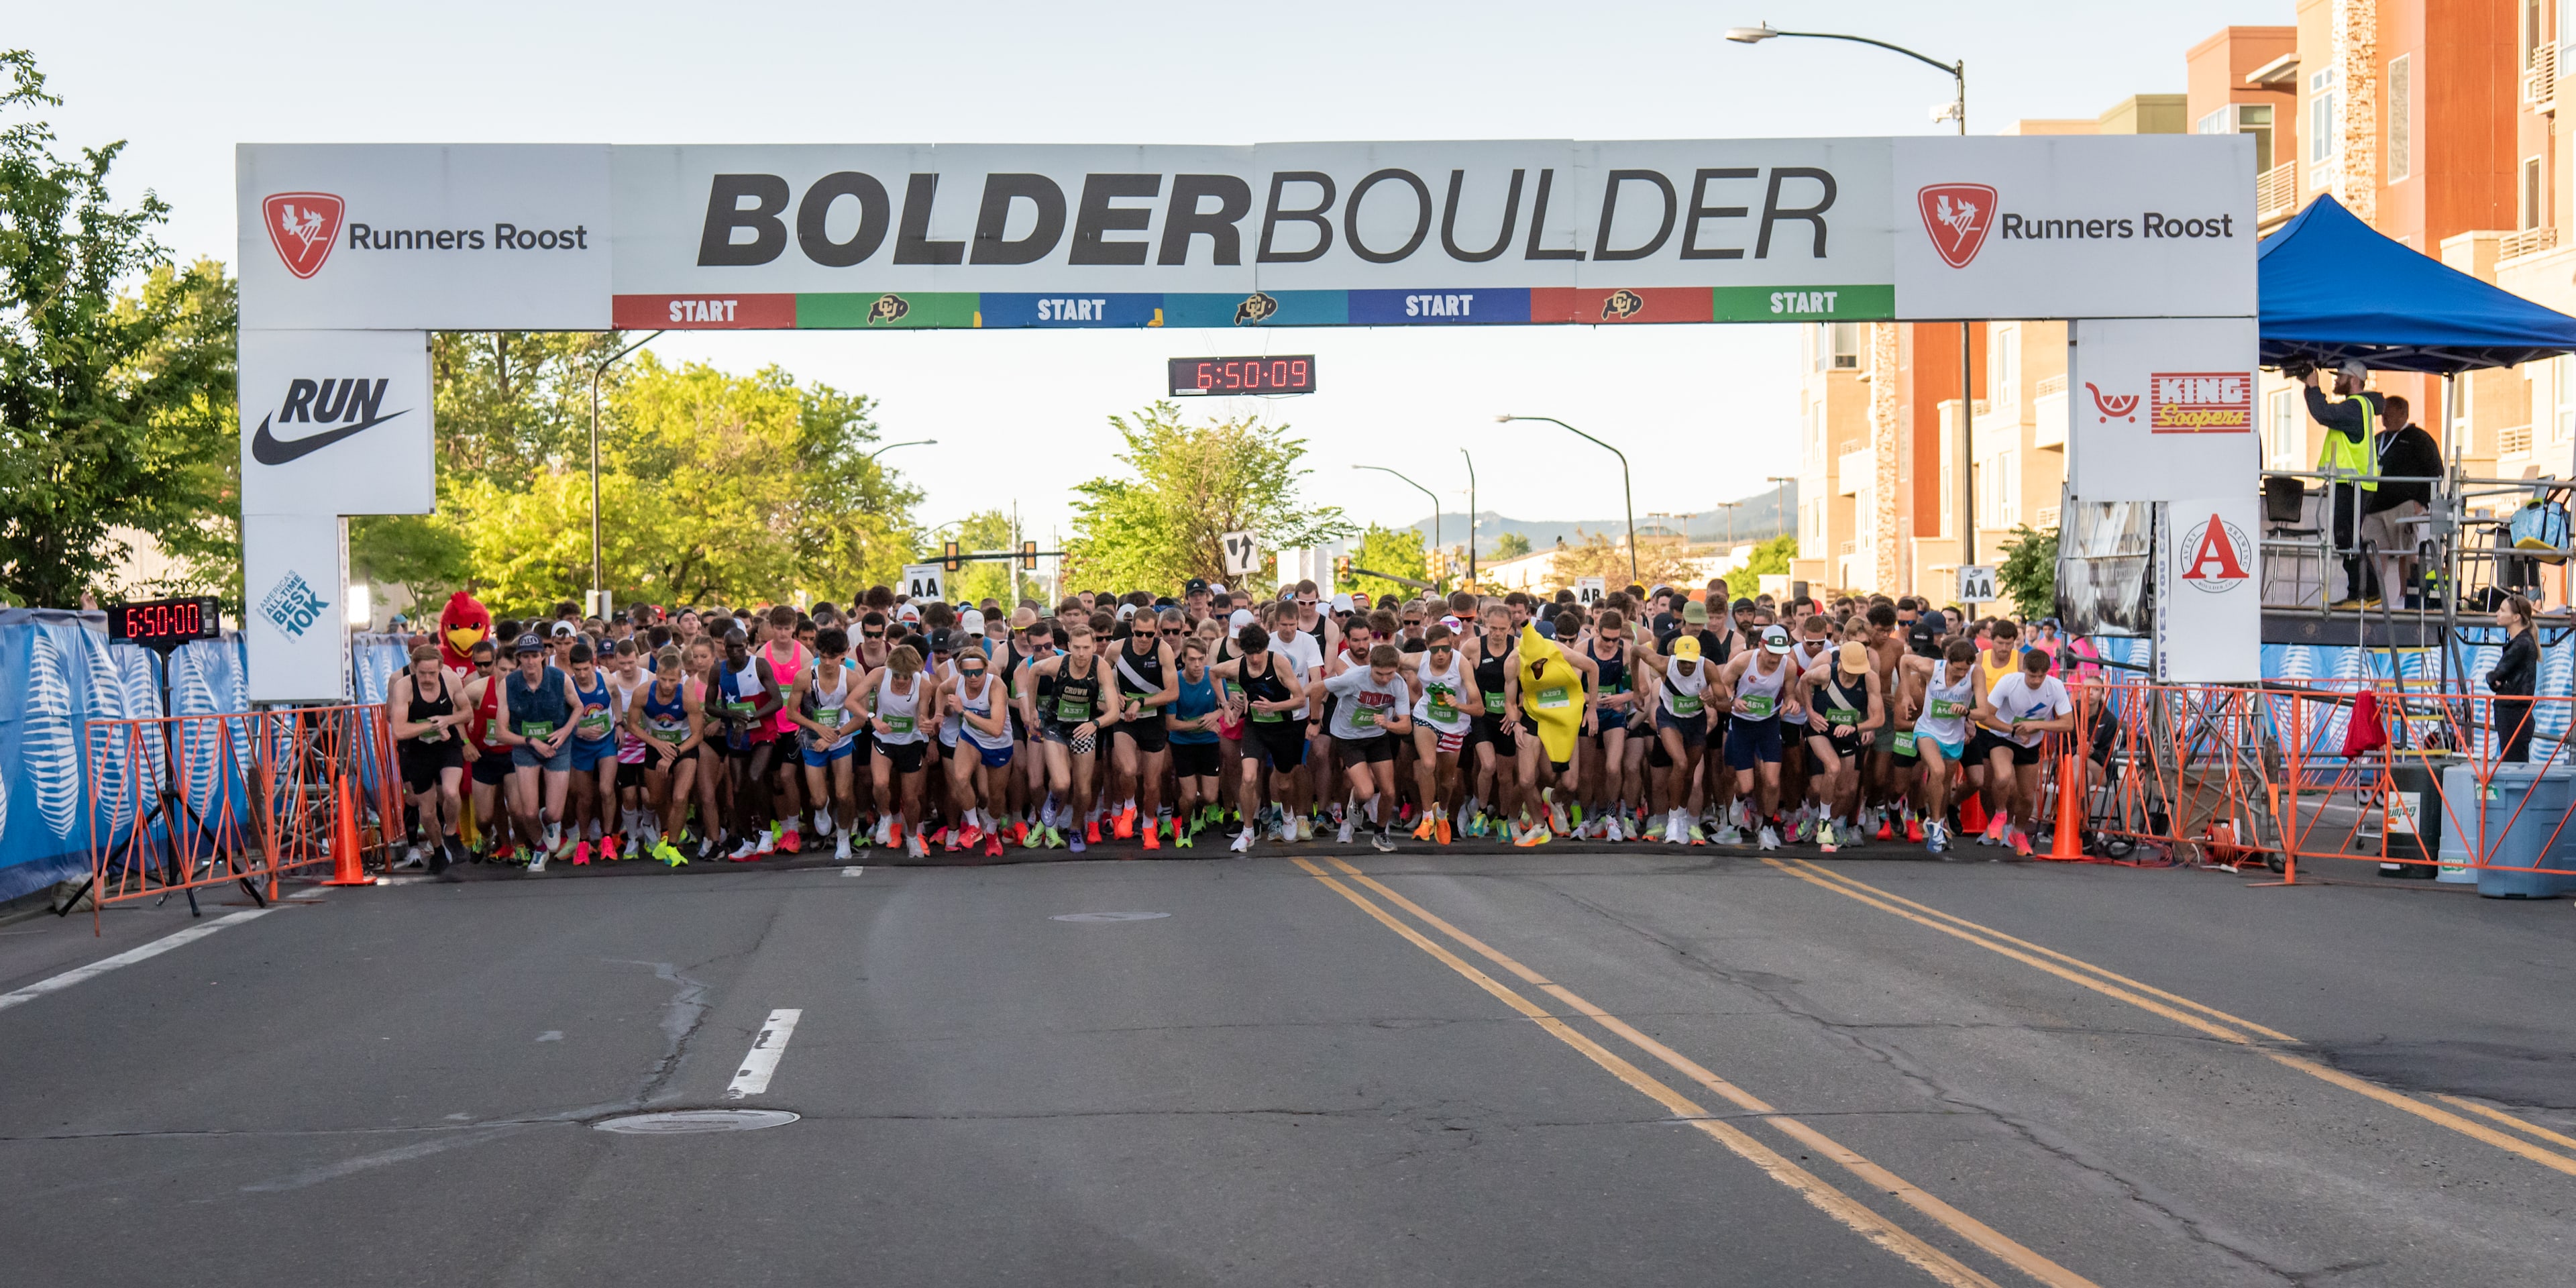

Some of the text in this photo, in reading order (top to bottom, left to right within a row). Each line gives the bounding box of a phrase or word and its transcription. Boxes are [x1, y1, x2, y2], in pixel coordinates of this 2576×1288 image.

[349, 223, 588, 250] Runners Roost
[2002, 212, 2233, 239] Runners Roost
[669, 299, 738, 323] START
[1038, 299, 1106, 322] START
[1405, 294, 1473, 317] START
[1770, 291, 1837, 315] START
[278, 378, 389, 424] RUN
[2159, 378, 2243, 404] KING
[2157, 403, 2244, 432] Soopers
[2182, 513, 2249, 579] A
[2184, 526, 2249, 568] AVERY BREWING
[260, 570, 296, 610] AMERICA'S
[266, 575, 302, 615] ALL-TIME
[911, 578, 939, 598] AA
[1964, 579, 1992, 598] AA
[272, 581, 311, 625] BEST
[286, 591, 330, 636] 10K
[2159, 652, 2167, 678] OH
[1064, 686, 1087, 696] CROWN
[1491, 700, 1505, 708] A34
